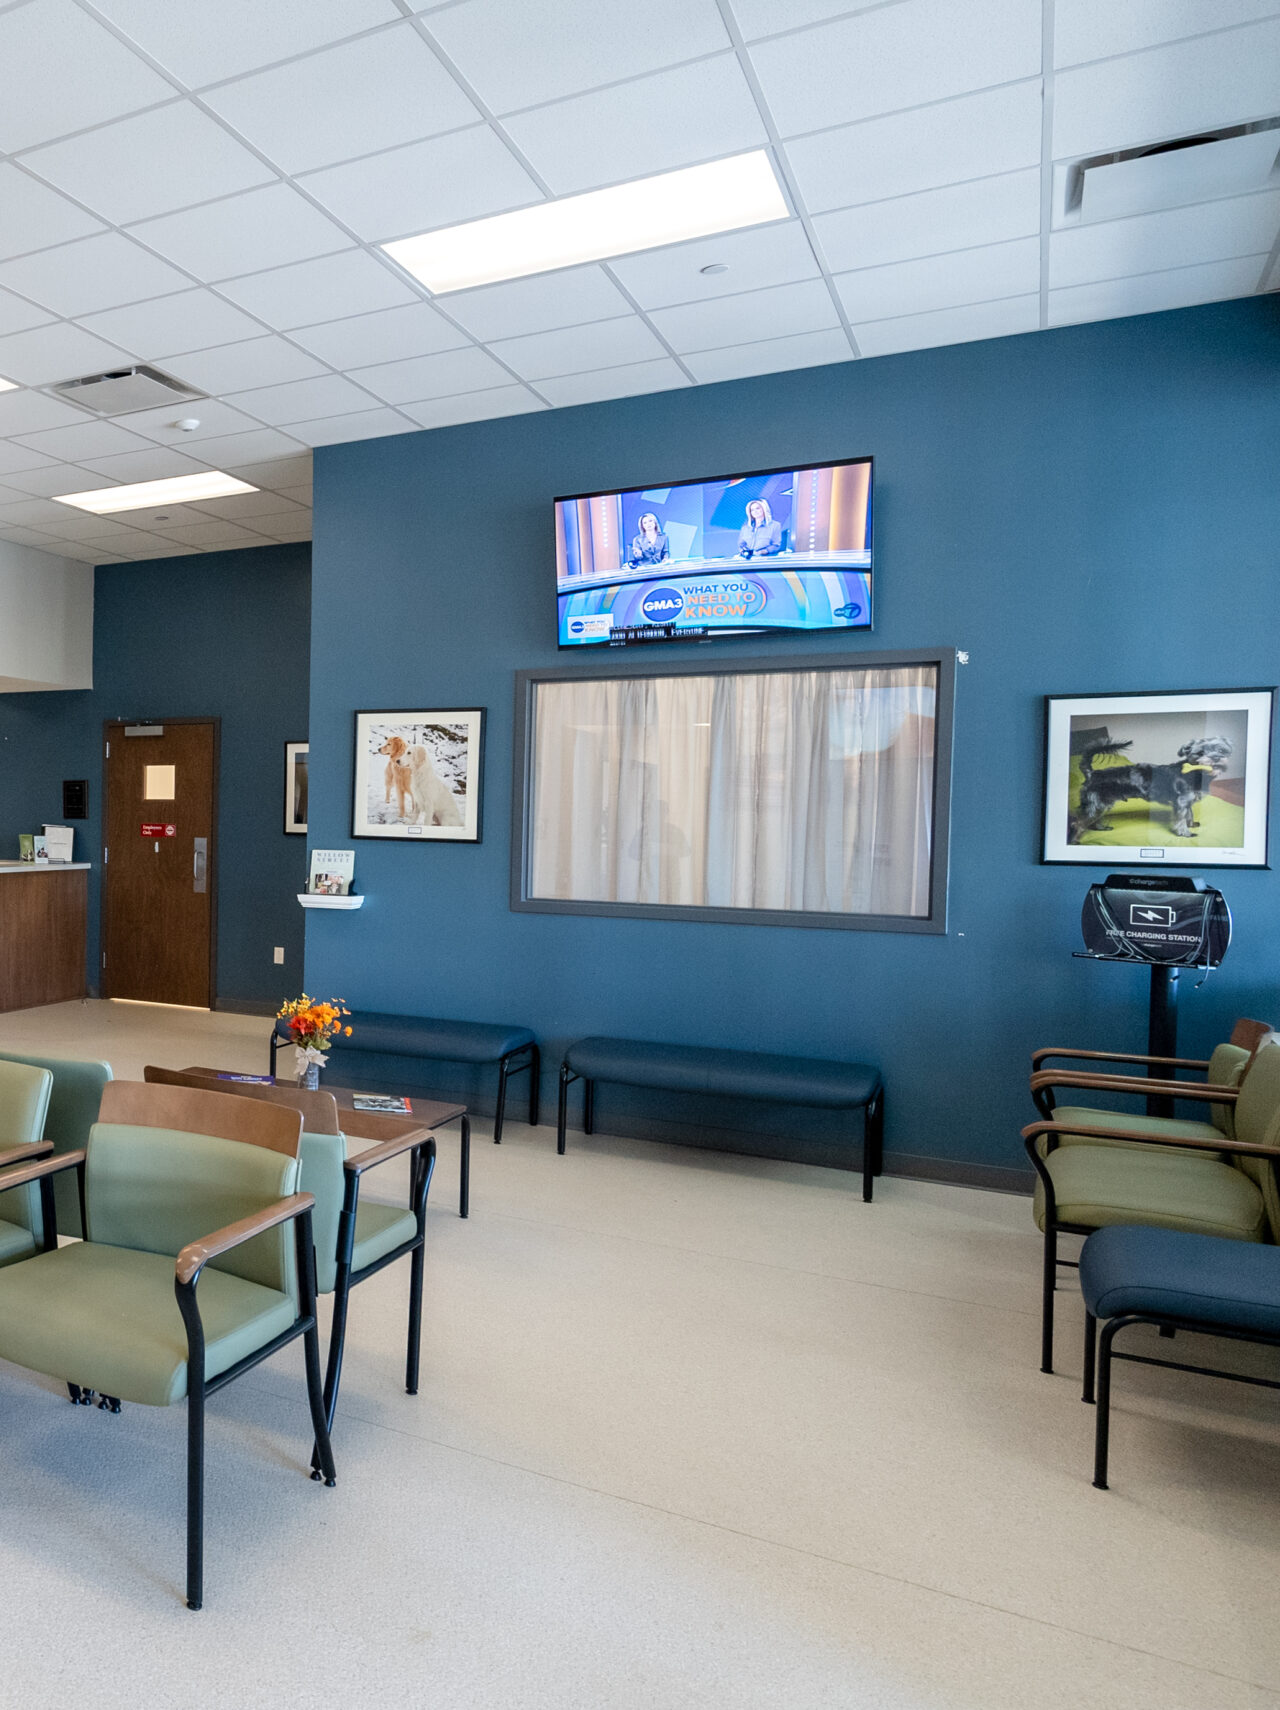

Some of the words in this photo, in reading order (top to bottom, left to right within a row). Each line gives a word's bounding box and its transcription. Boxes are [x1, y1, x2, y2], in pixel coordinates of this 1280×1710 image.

[683, 584, 719, 595] WHAT
[722, 583, 749, 592] YOU
[643, 598, 683, 612] GMA3
[688, 593, 729, 605] NEED
[736, 592, 756, 602] TO
[685, 604, 747, 618] KNOW
[1126, 931, 1167, 940] CHARGING
[1168, 934, 1202, 942] STATION
